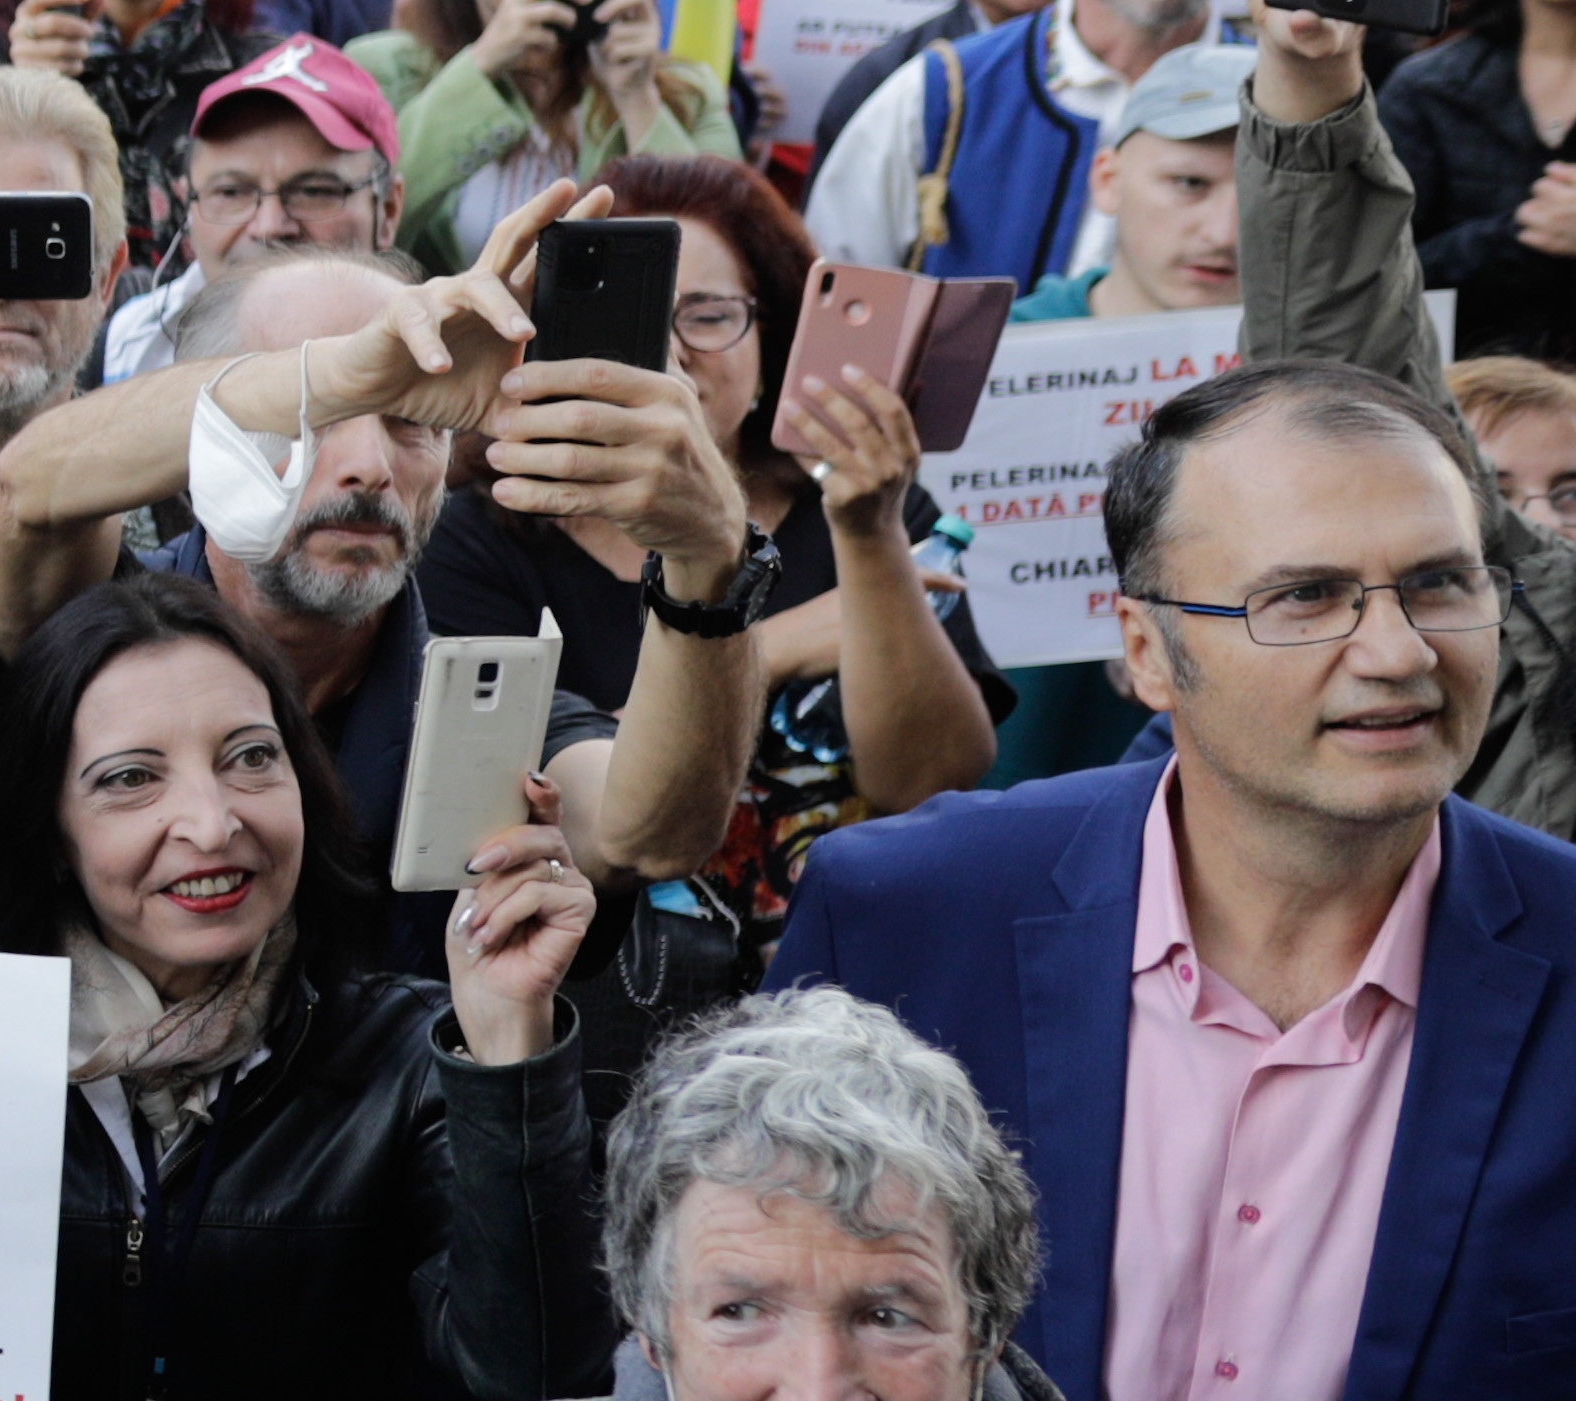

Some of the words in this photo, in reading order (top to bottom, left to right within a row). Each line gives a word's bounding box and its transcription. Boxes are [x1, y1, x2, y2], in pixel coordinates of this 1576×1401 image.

[988, 366, 1139, 397] ELERINAJ
[1151, 357, 1199, 382] LA
[950, 463, 1110, 491] PELERINA
[982, 493, 1066, 522] DATĂ
